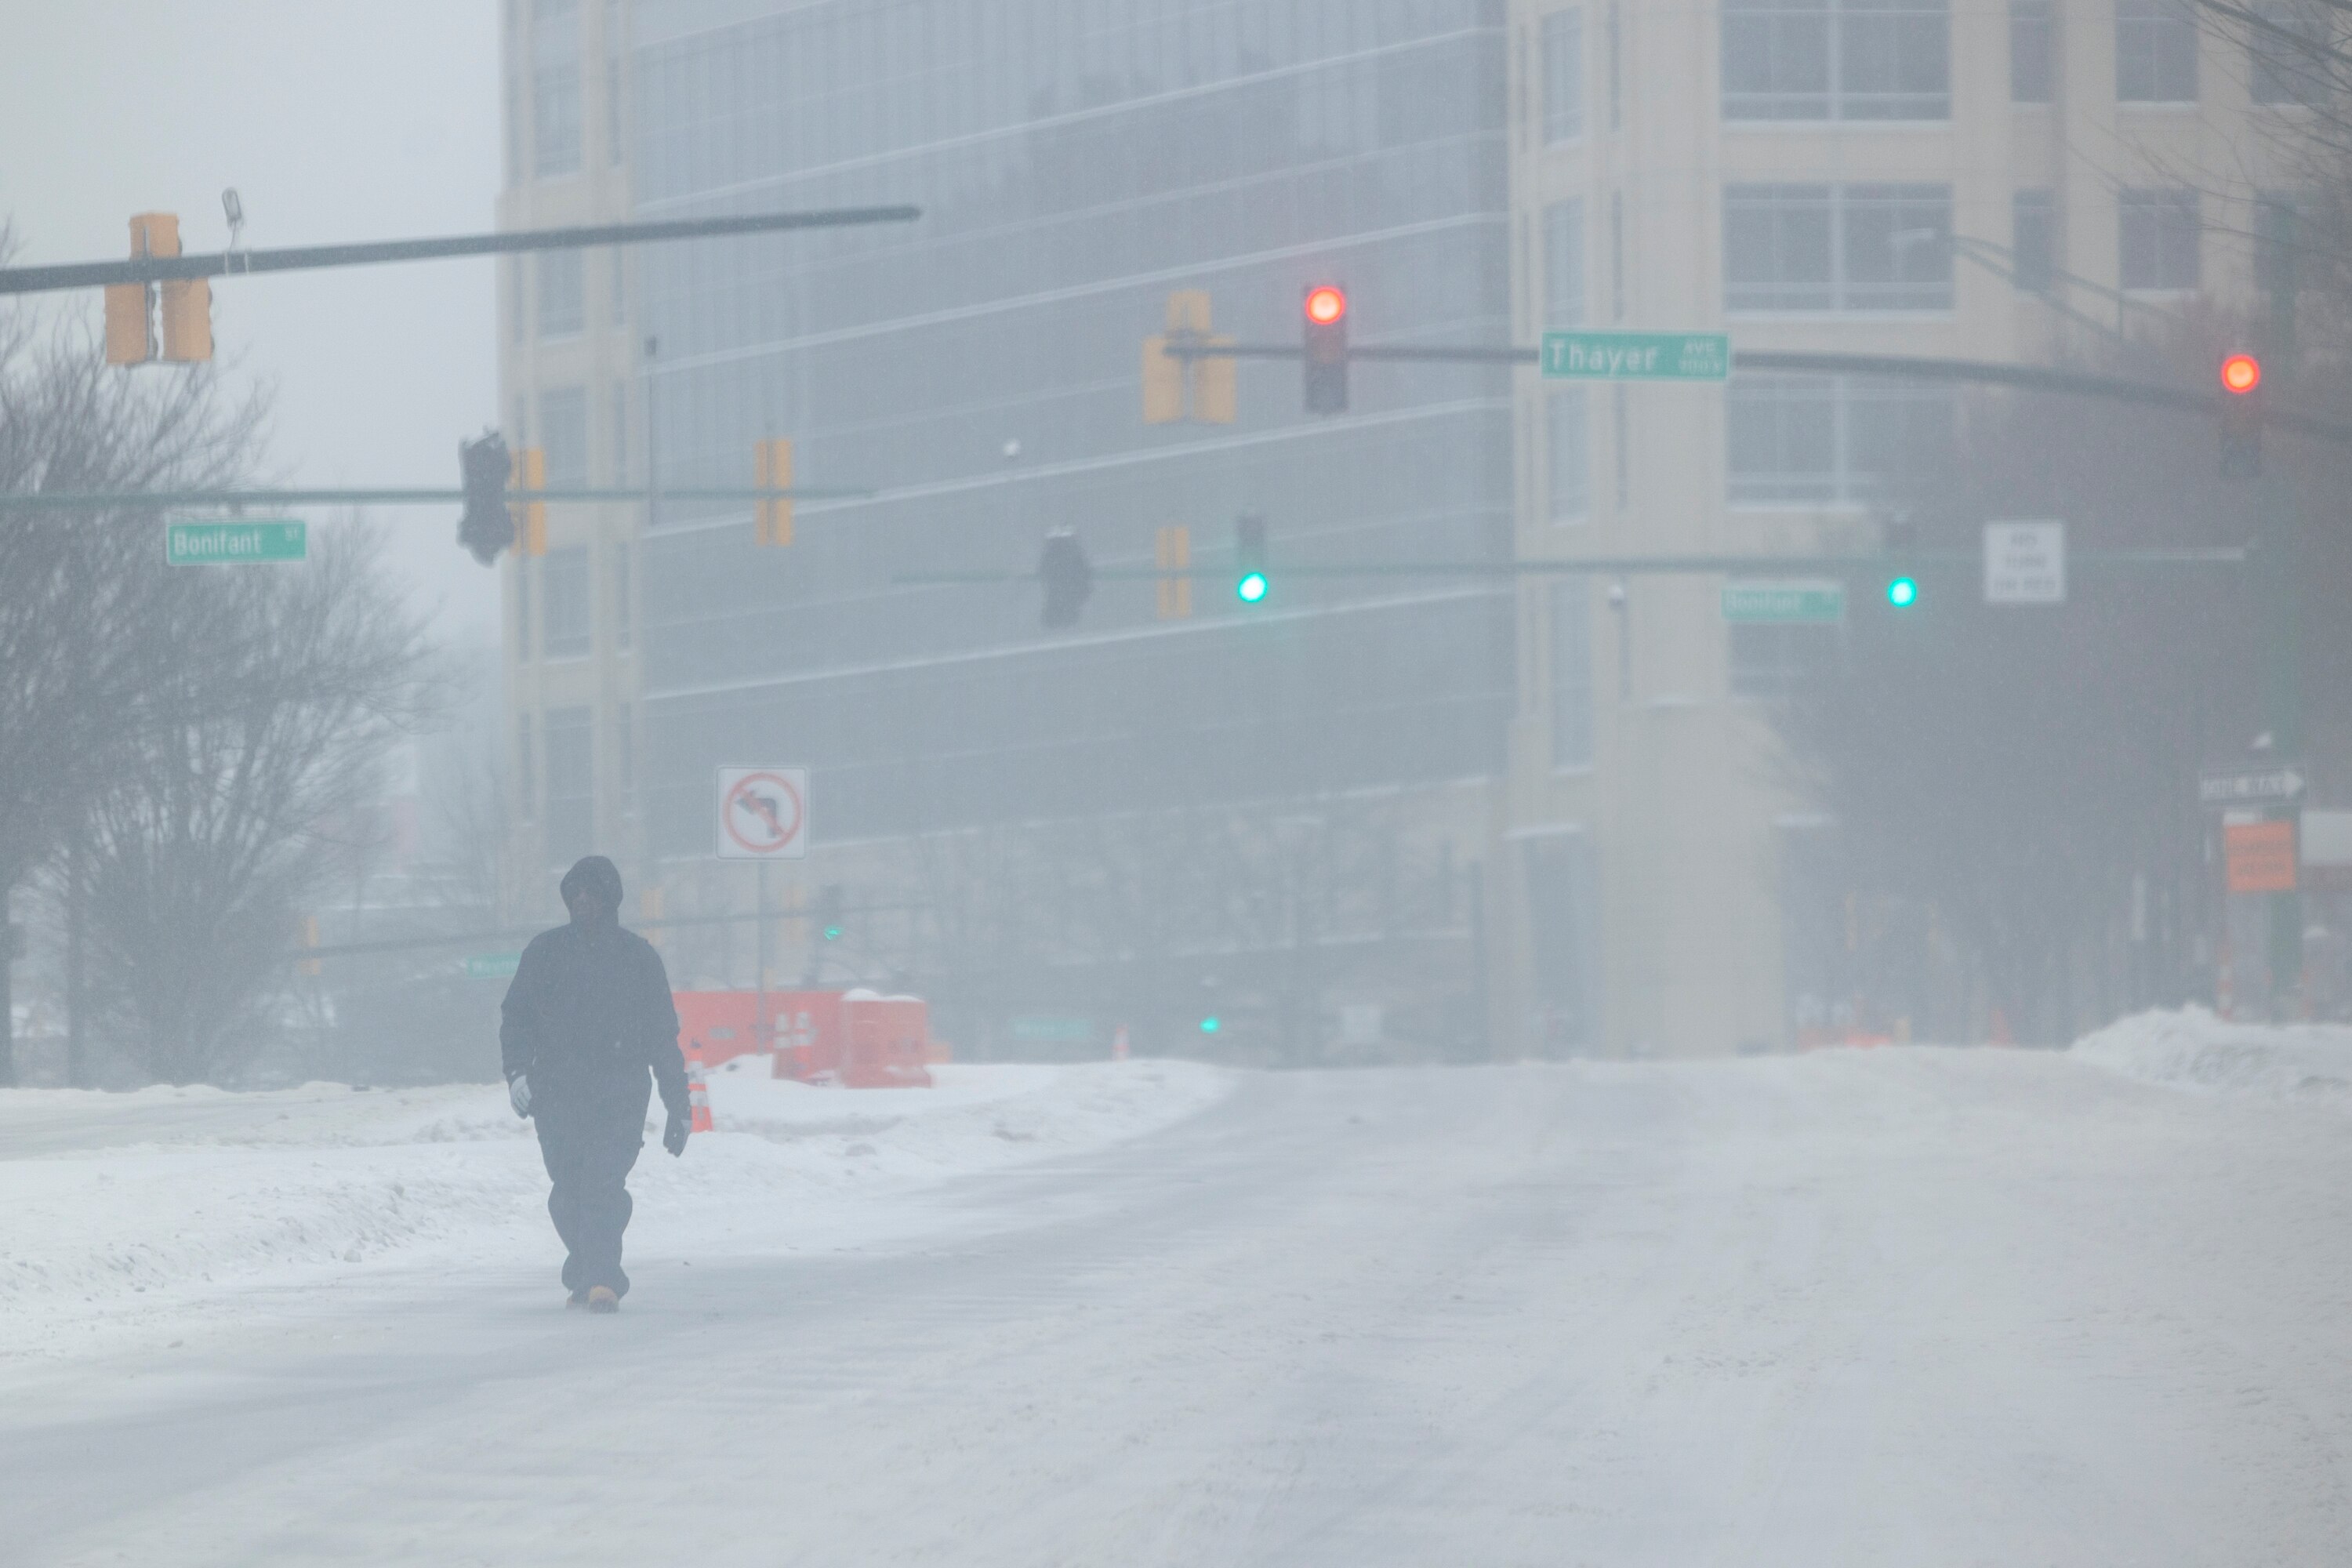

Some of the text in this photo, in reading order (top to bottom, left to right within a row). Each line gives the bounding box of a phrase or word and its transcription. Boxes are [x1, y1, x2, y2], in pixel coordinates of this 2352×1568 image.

[1549, 339, 1658, 378] Thayer
[1683, 339, 1715, 355] AVE
[174, 529, 262, 556] Bonifant
